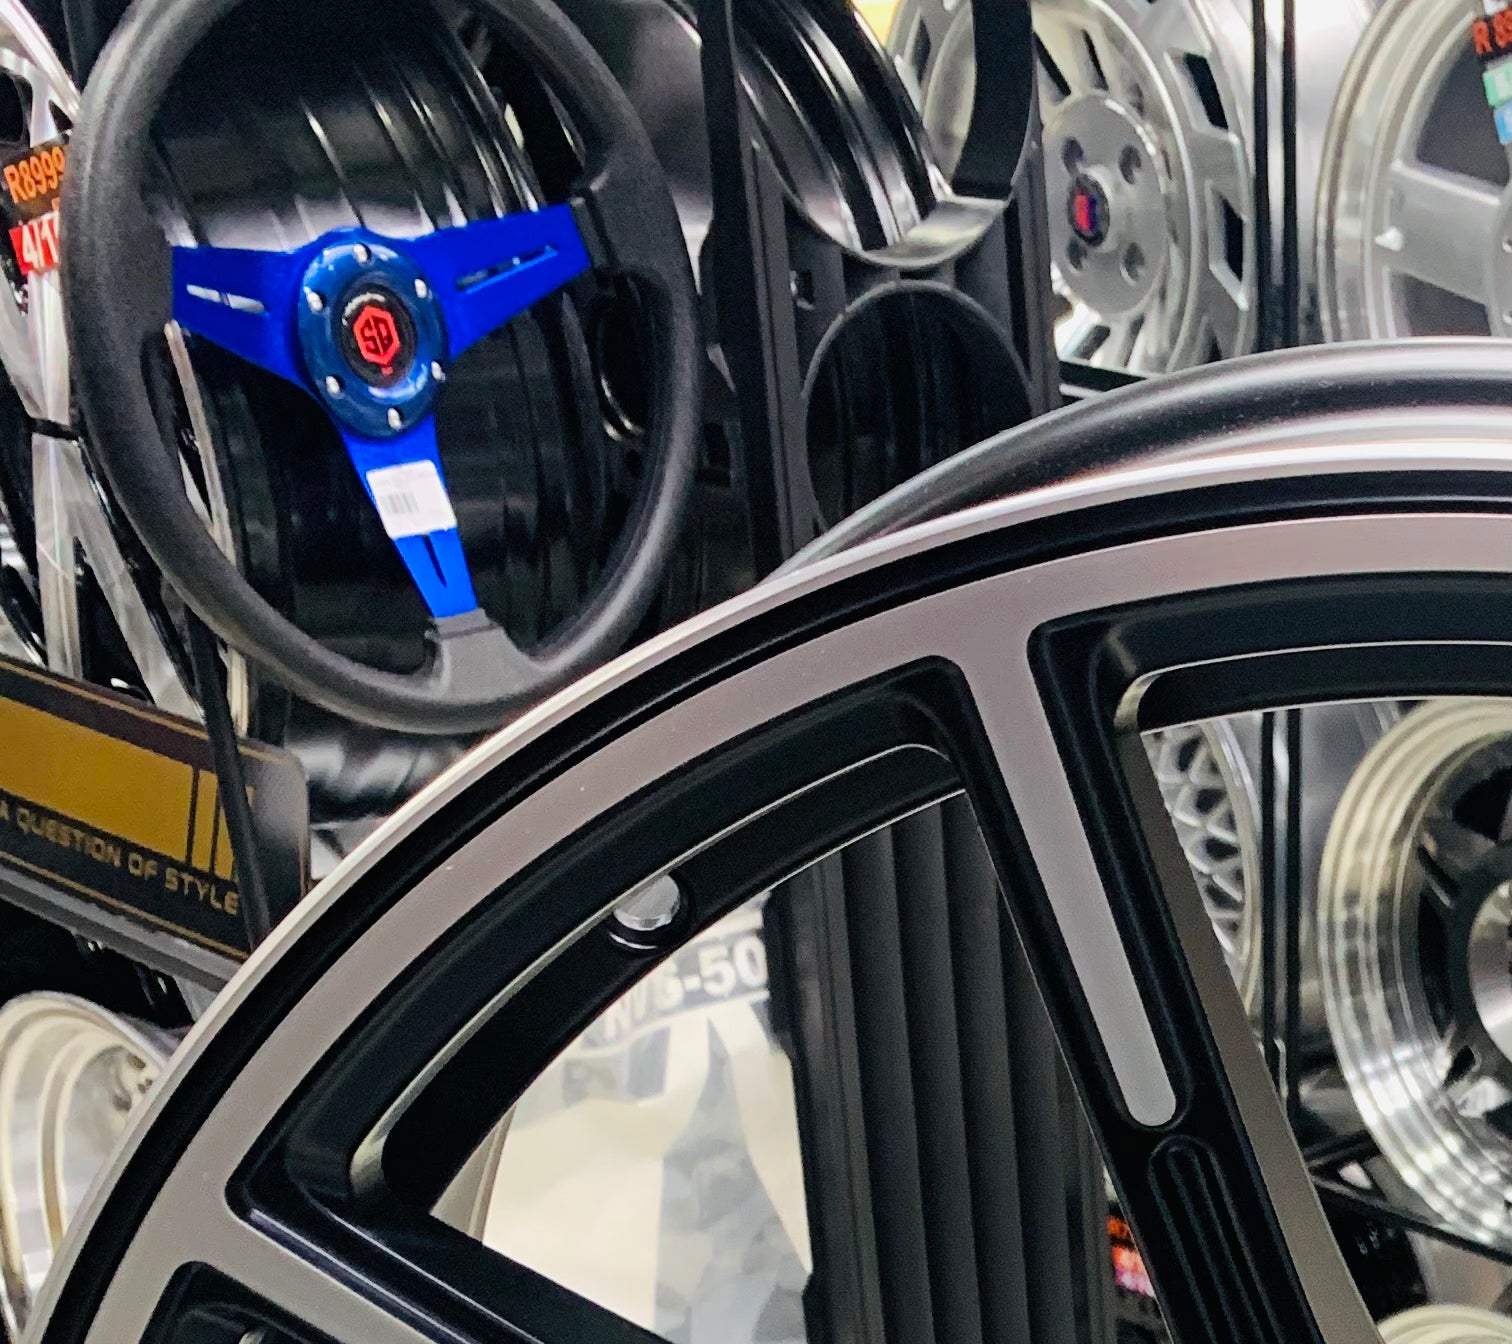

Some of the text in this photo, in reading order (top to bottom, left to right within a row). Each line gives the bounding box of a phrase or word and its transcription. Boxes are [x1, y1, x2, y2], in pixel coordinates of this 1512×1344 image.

[16, 807, 121, 868] QUESTION
[127, 852, 158, 881] OF
[164, 867, 240, 916] STYLE
